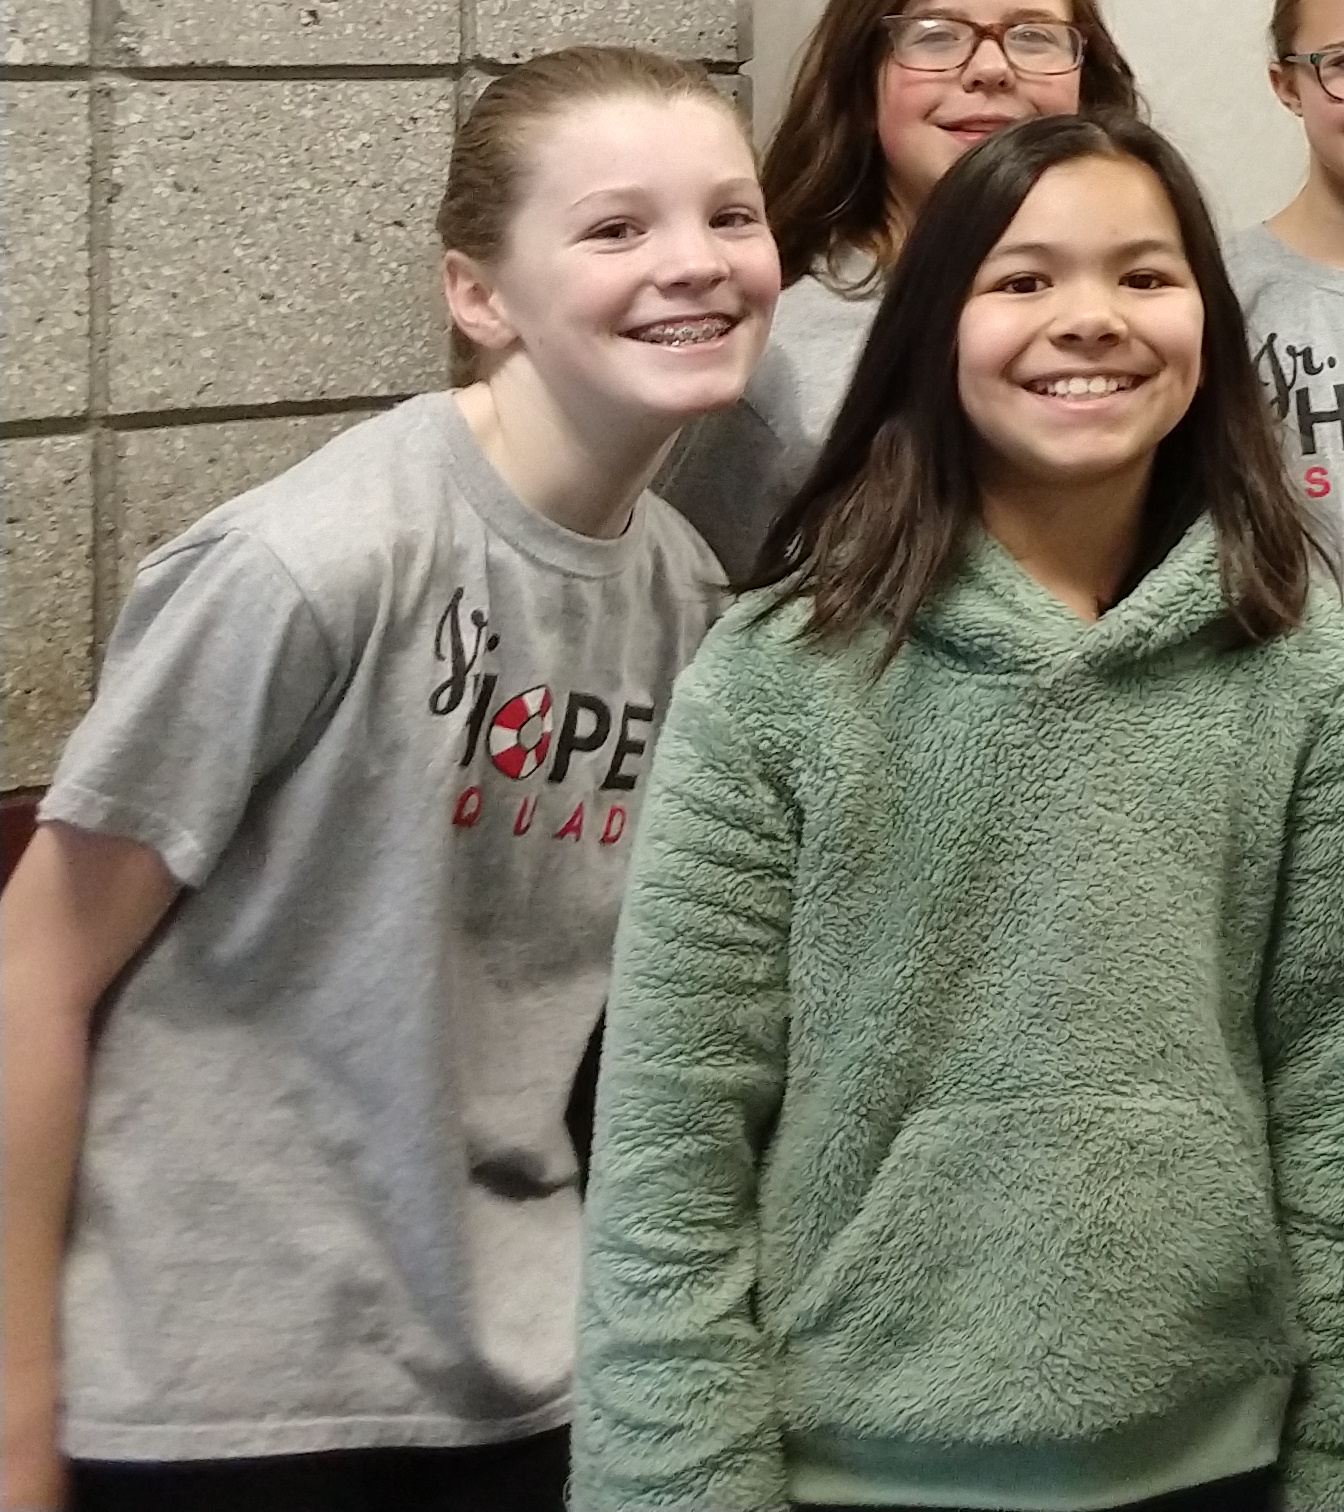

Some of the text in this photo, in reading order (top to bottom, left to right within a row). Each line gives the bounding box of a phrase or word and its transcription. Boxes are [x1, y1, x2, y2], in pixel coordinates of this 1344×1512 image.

[1255, 333, 1337, 420] Jr.
[429, 586, 501, 716] Jr.
[453, 785, 626, 846] QUAD
